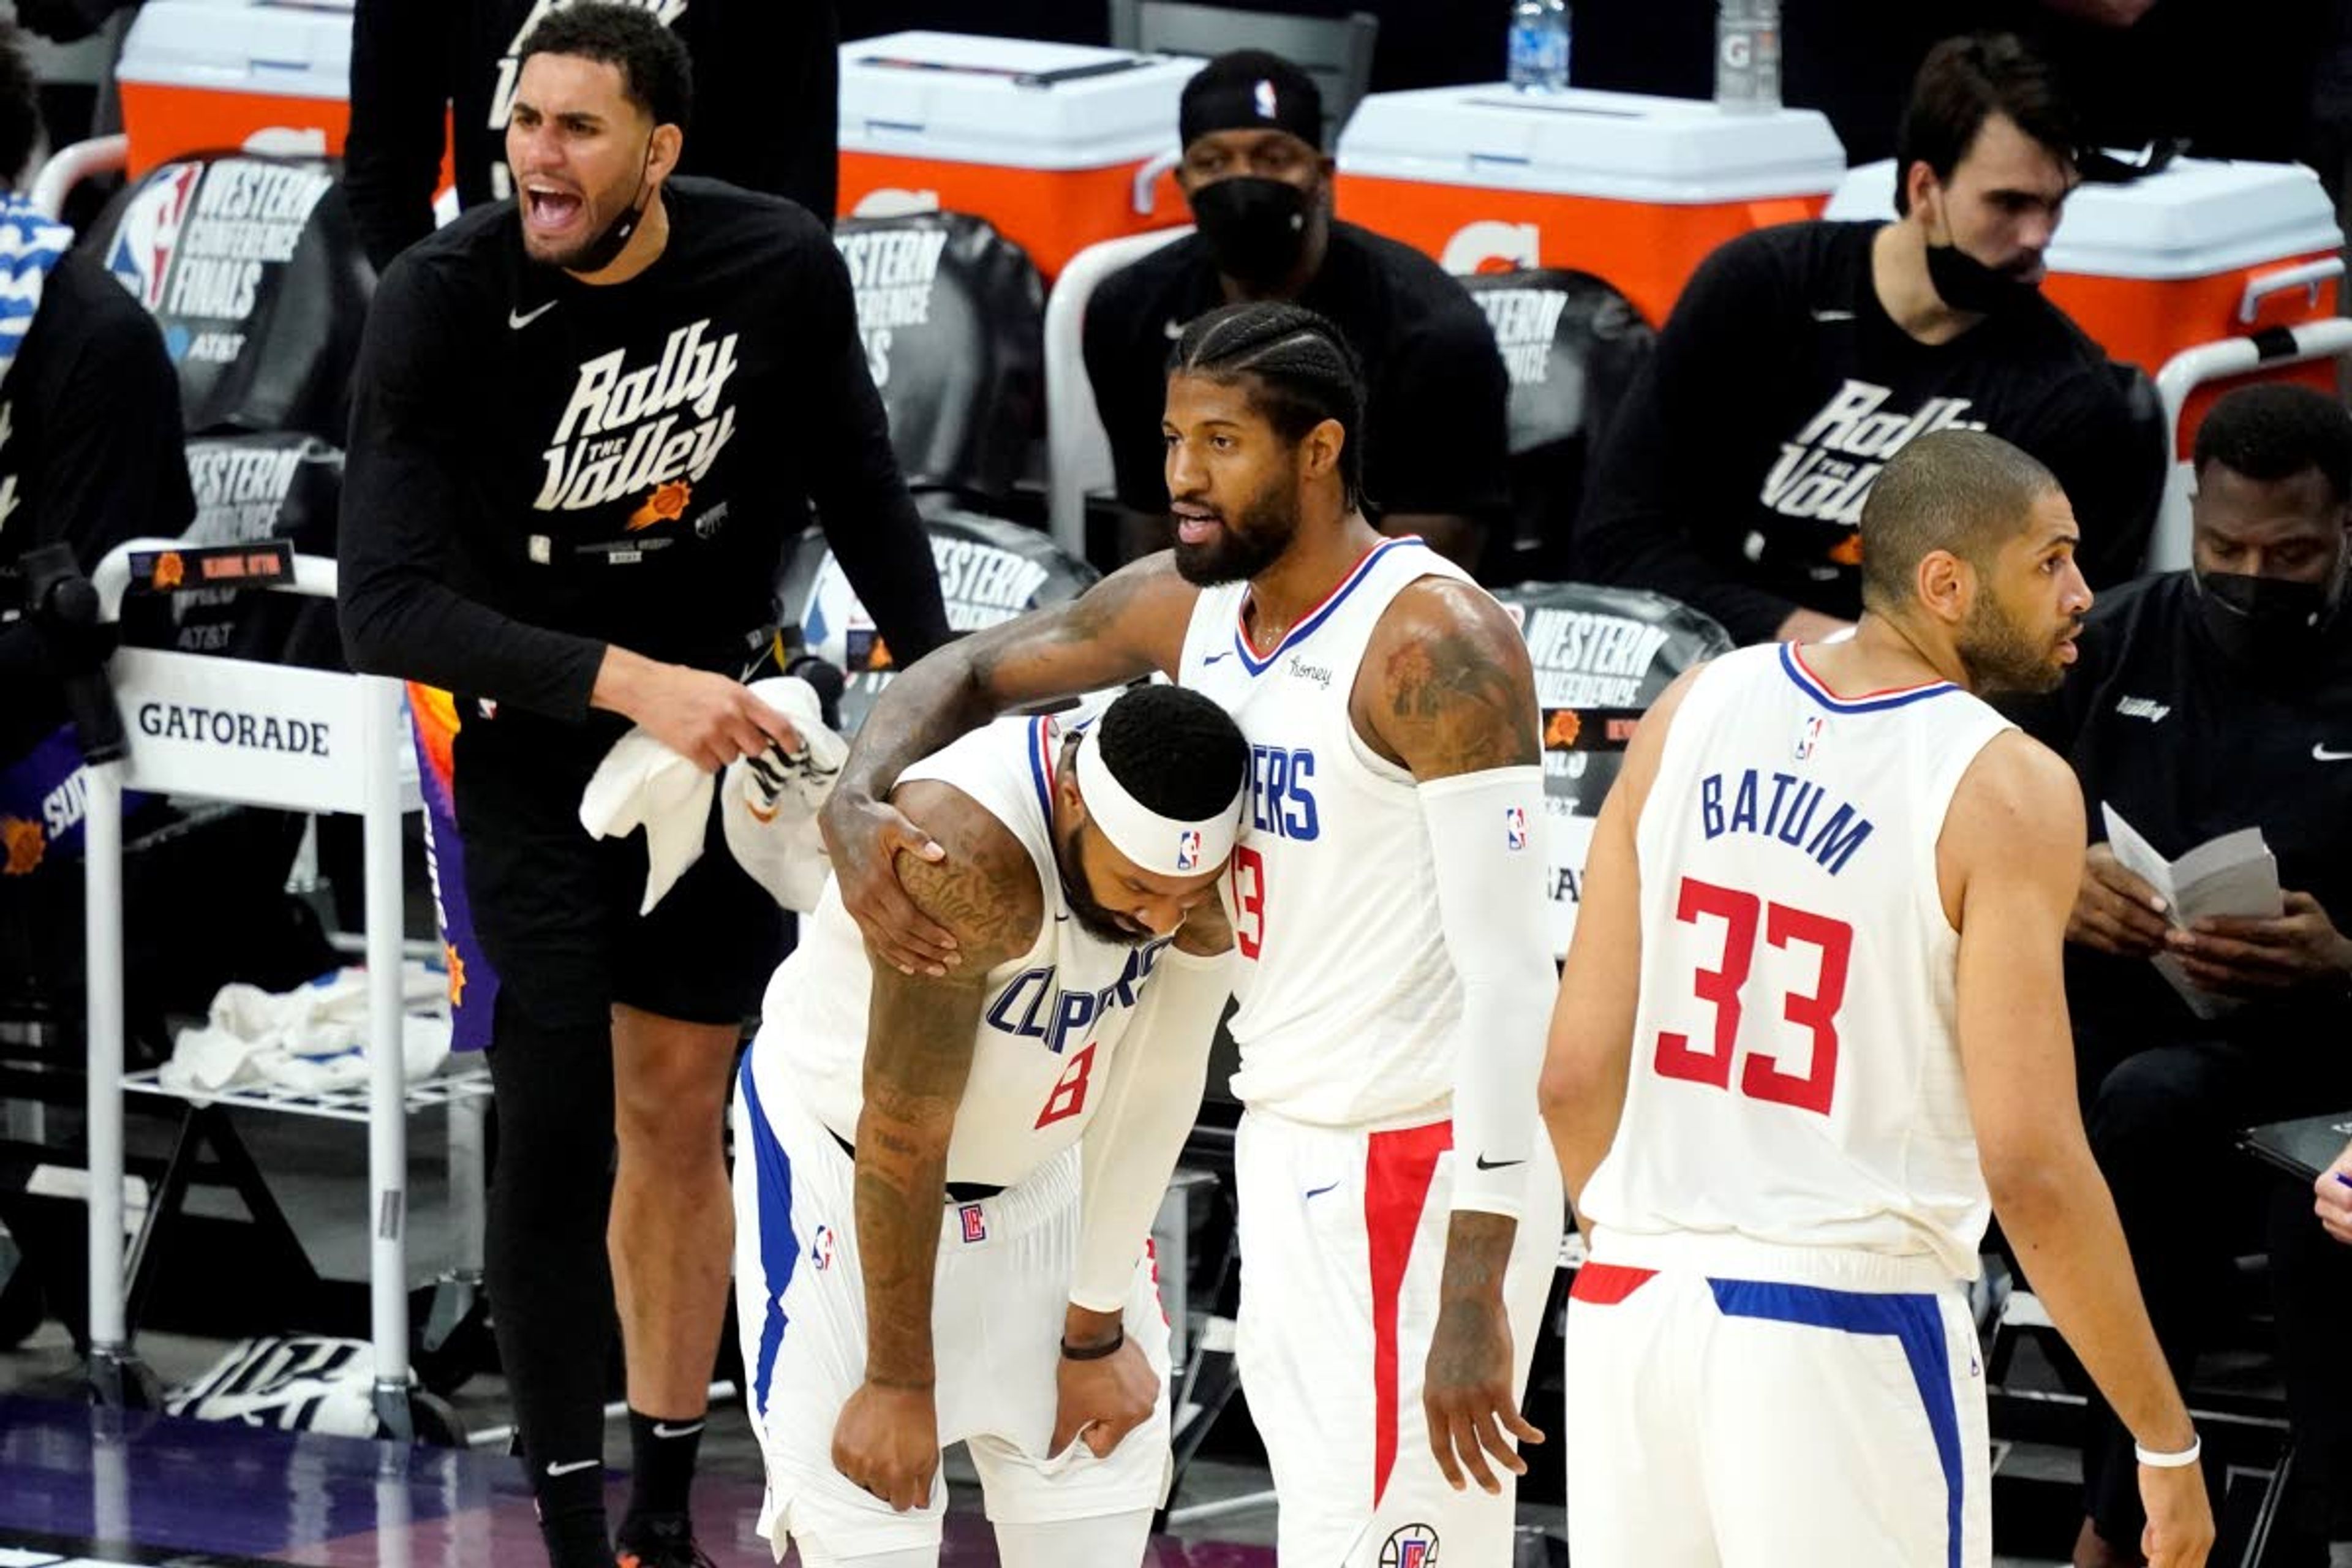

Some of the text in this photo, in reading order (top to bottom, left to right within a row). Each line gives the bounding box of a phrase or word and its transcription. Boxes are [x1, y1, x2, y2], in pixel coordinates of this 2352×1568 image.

[196, 159, 334, 221] WESTERN
[551, 317, 738, 446] Rally
[532, 404, 736, 511] Valley
[589, 437, 627, 462] THE
[139, 703, 330, 756] GATORADE
[1702, 769, 1874, 876] BATUM
[1654, 876, 1853, 1117] 33
[1034, 1041, 1098, 1130] 8
